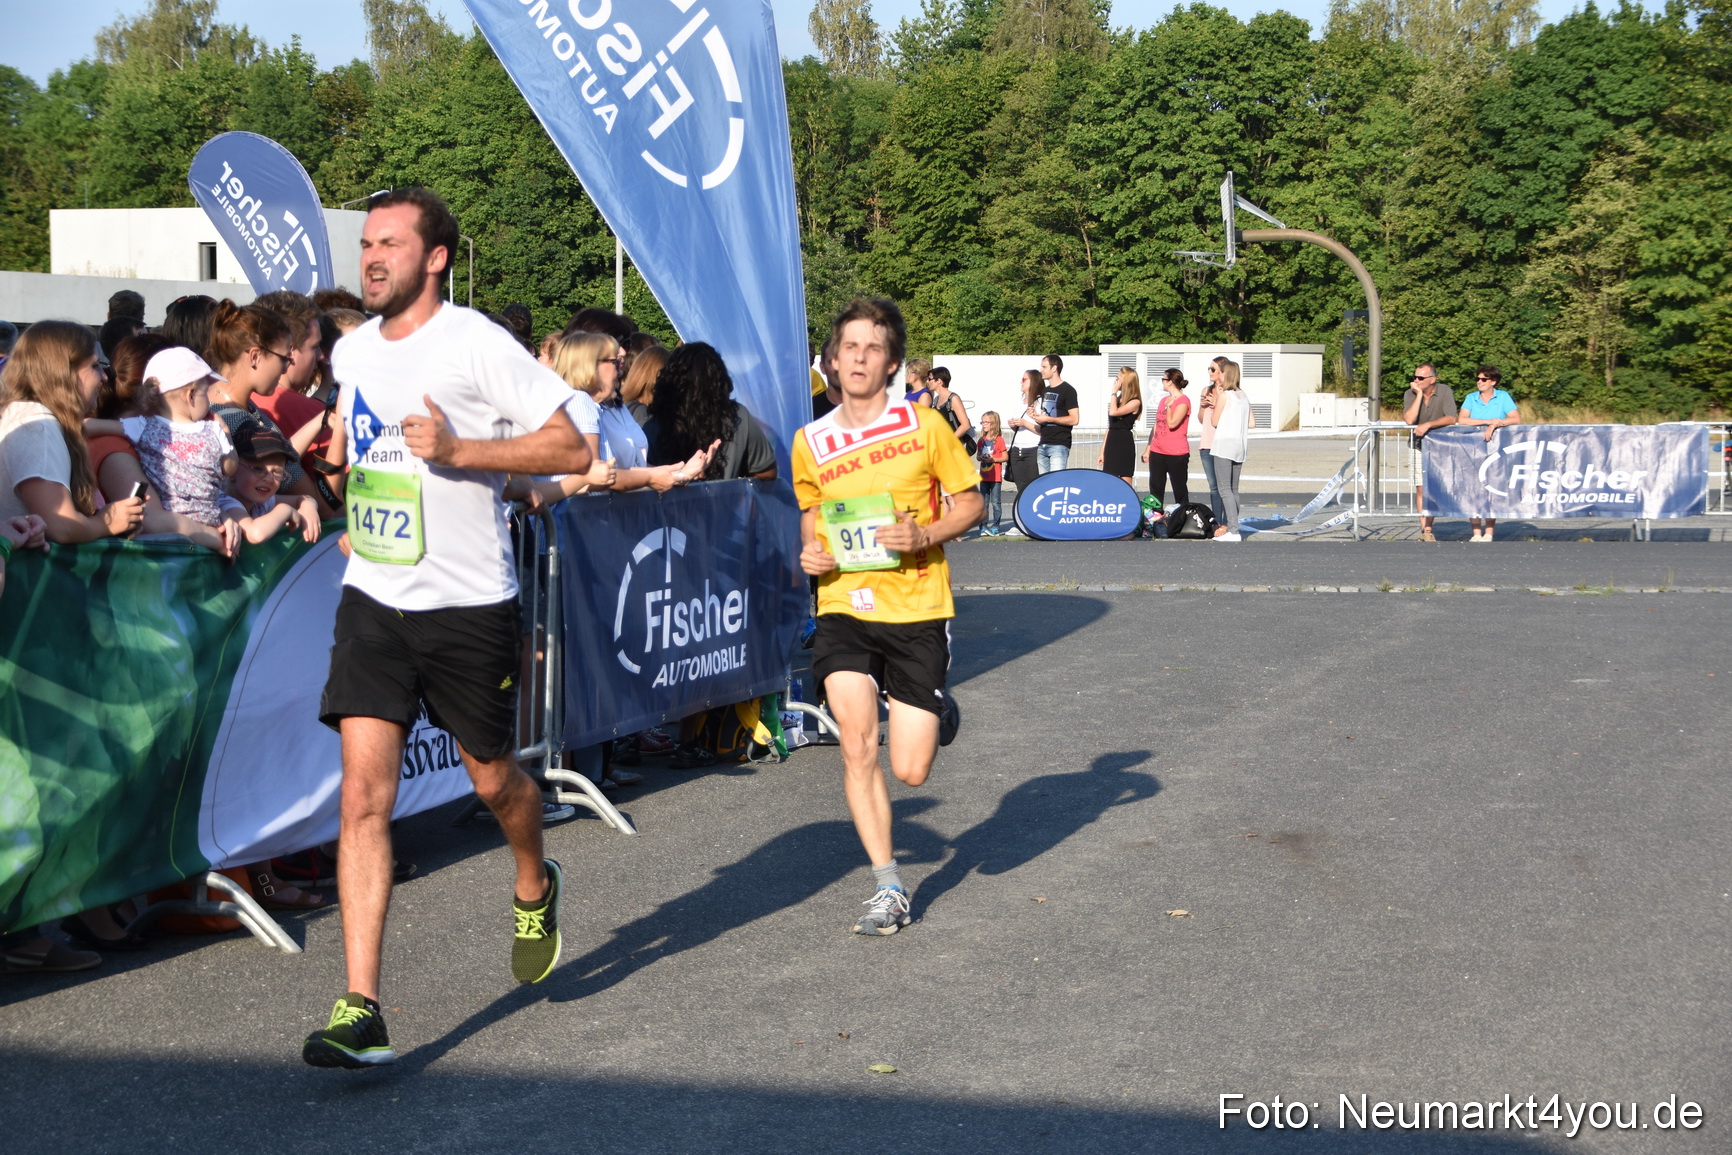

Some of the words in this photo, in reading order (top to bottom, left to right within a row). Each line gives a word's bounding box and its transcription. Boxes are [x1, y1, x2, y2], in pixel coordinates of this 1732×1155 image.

[356, 414, 404, 439] Runni
[362, 448, 403, 463] Team
[819, 457, 864, 486] MAX
[868, 438, 925, 465] BÖGL
[1509, 464, 1648, 489] Fischer
[1051, 500, 1126, 516] Fischer
[1520, 492, 1636, 504] AUTOMOBILE
[352, 502, 411, 539] 1472
[1059, 516, 1122, 524] AUTOMOBILE
[652, 643, 747, 688] AUTOMOBILE
